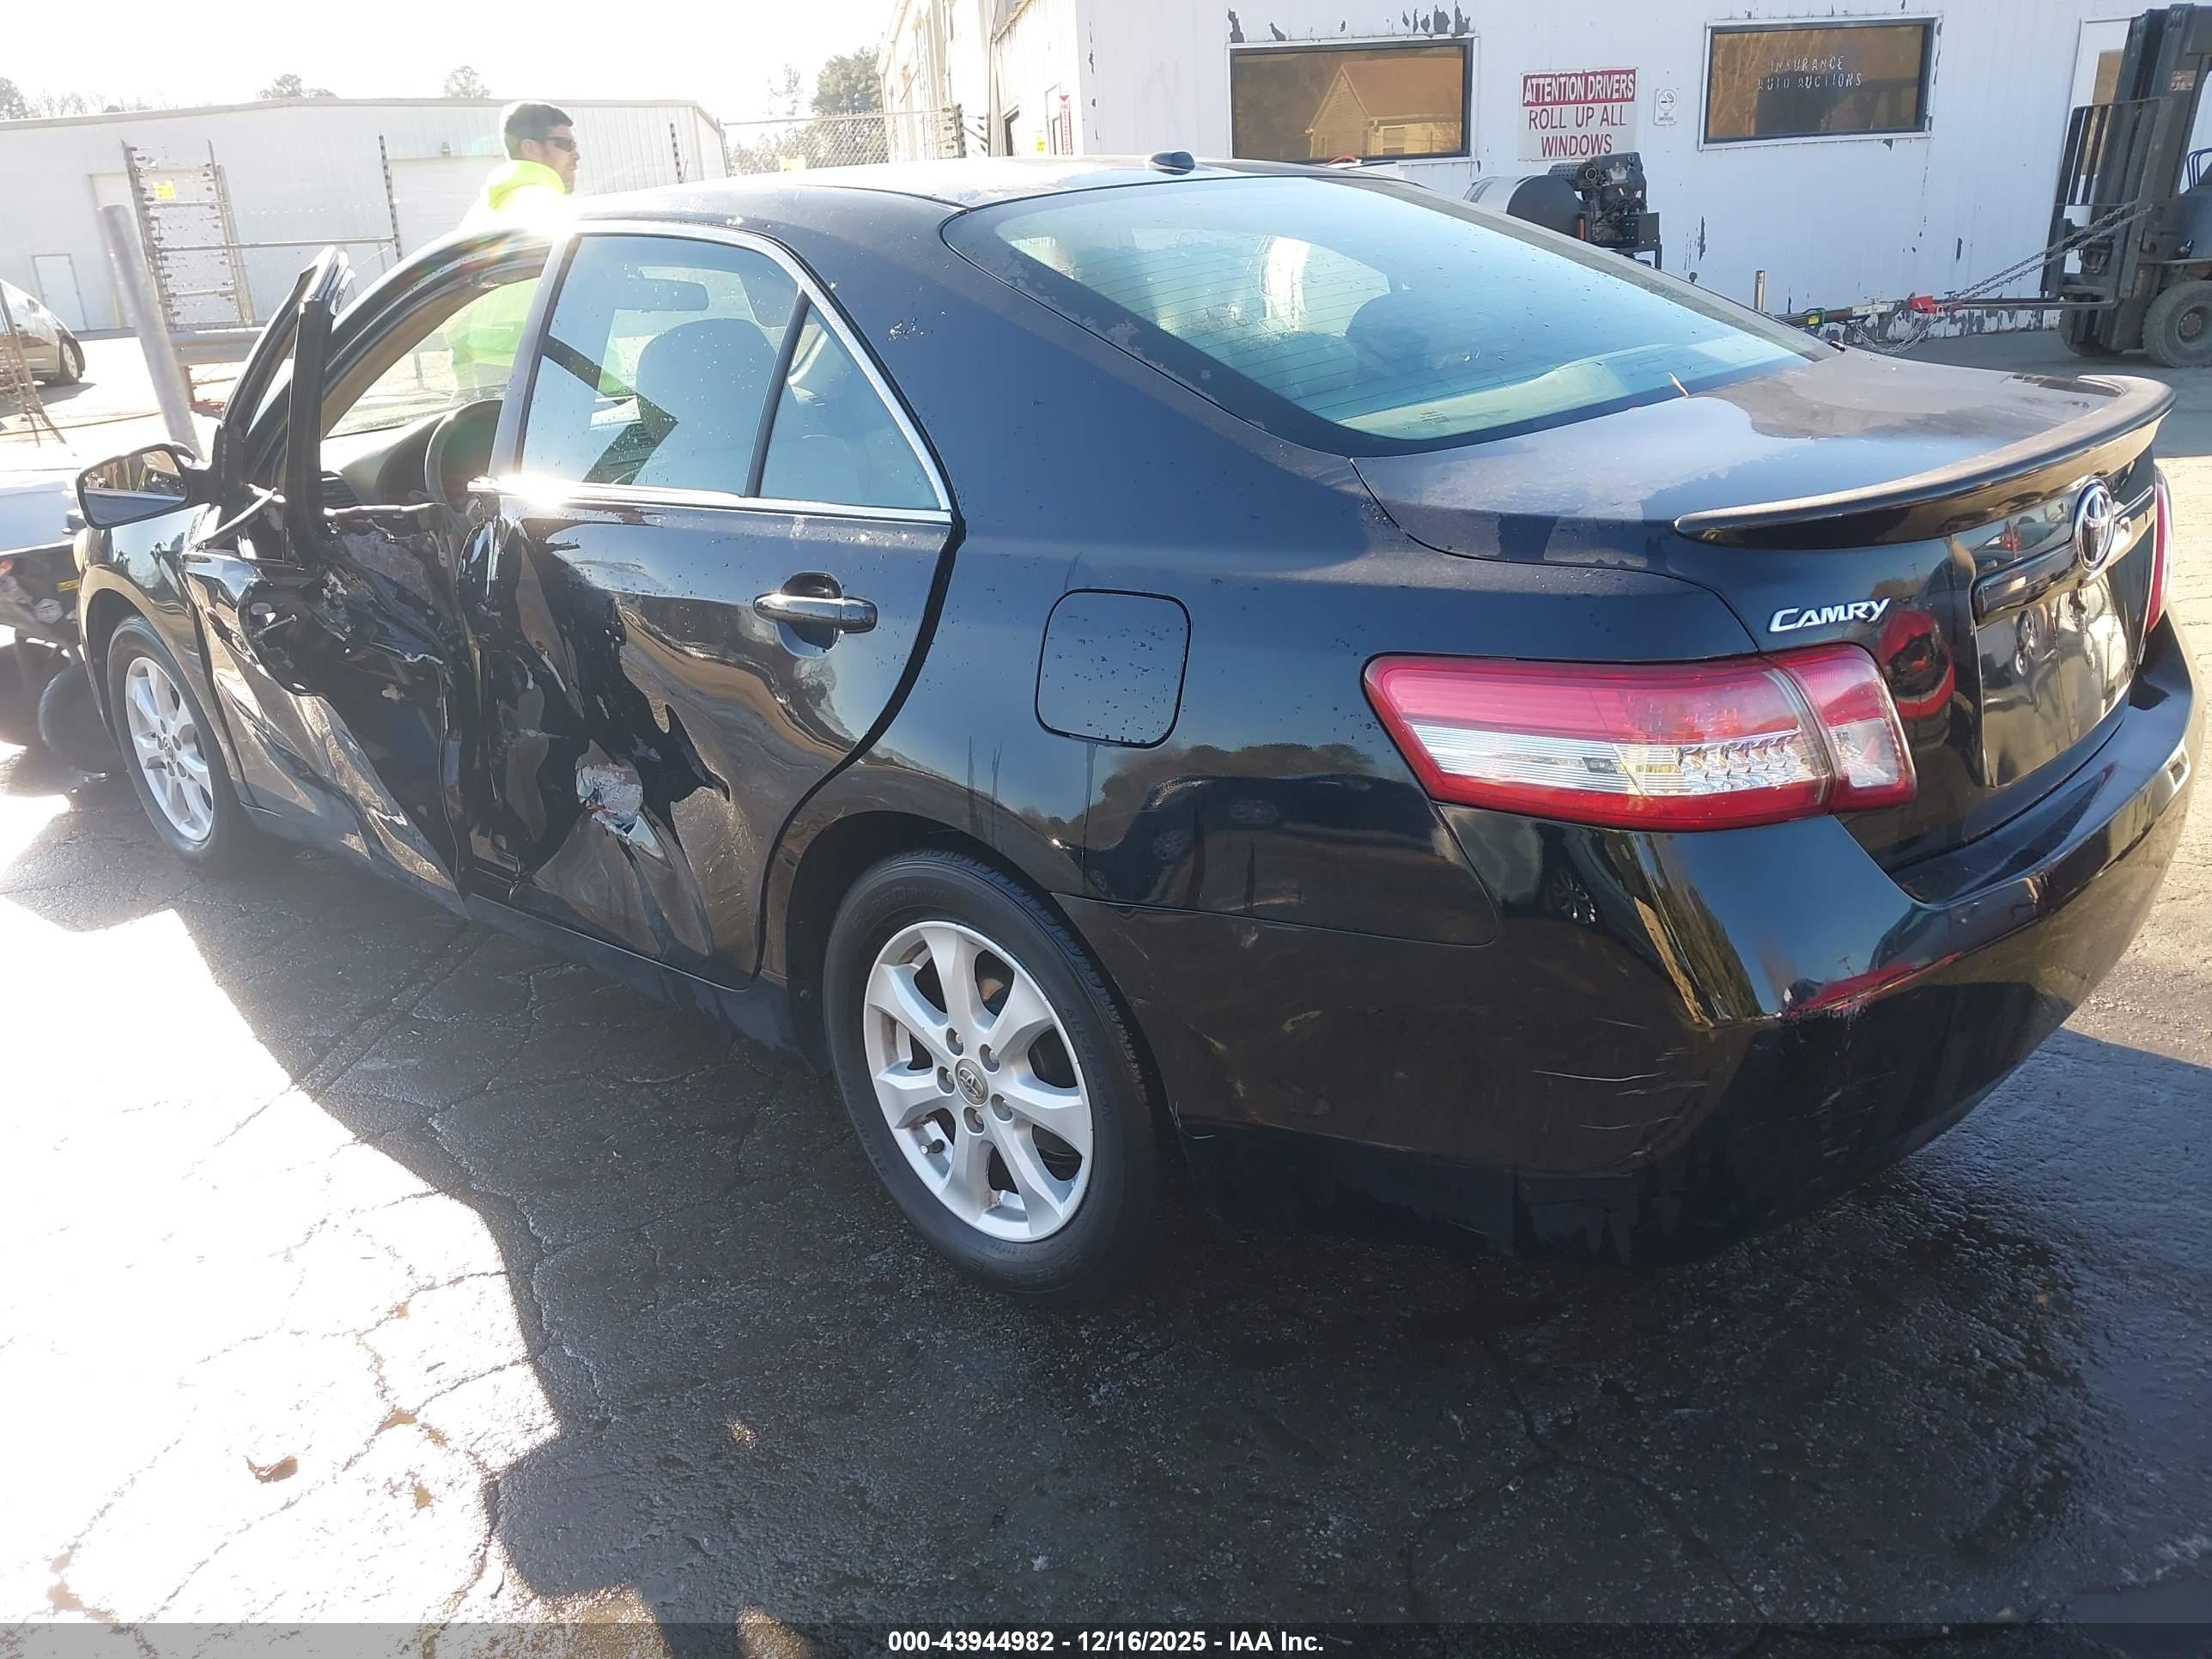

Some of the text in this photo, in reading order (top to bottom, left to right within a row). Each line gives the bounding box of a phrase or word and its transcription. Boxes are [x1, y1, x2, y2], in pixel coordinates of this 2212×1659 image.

[1524, 74, 1634, 103] ATTENTION DRIVERS
[1528, 105, 1626, 131] ROLL UP ALL
[1540, 133, 1612, 157] WINDOWS
